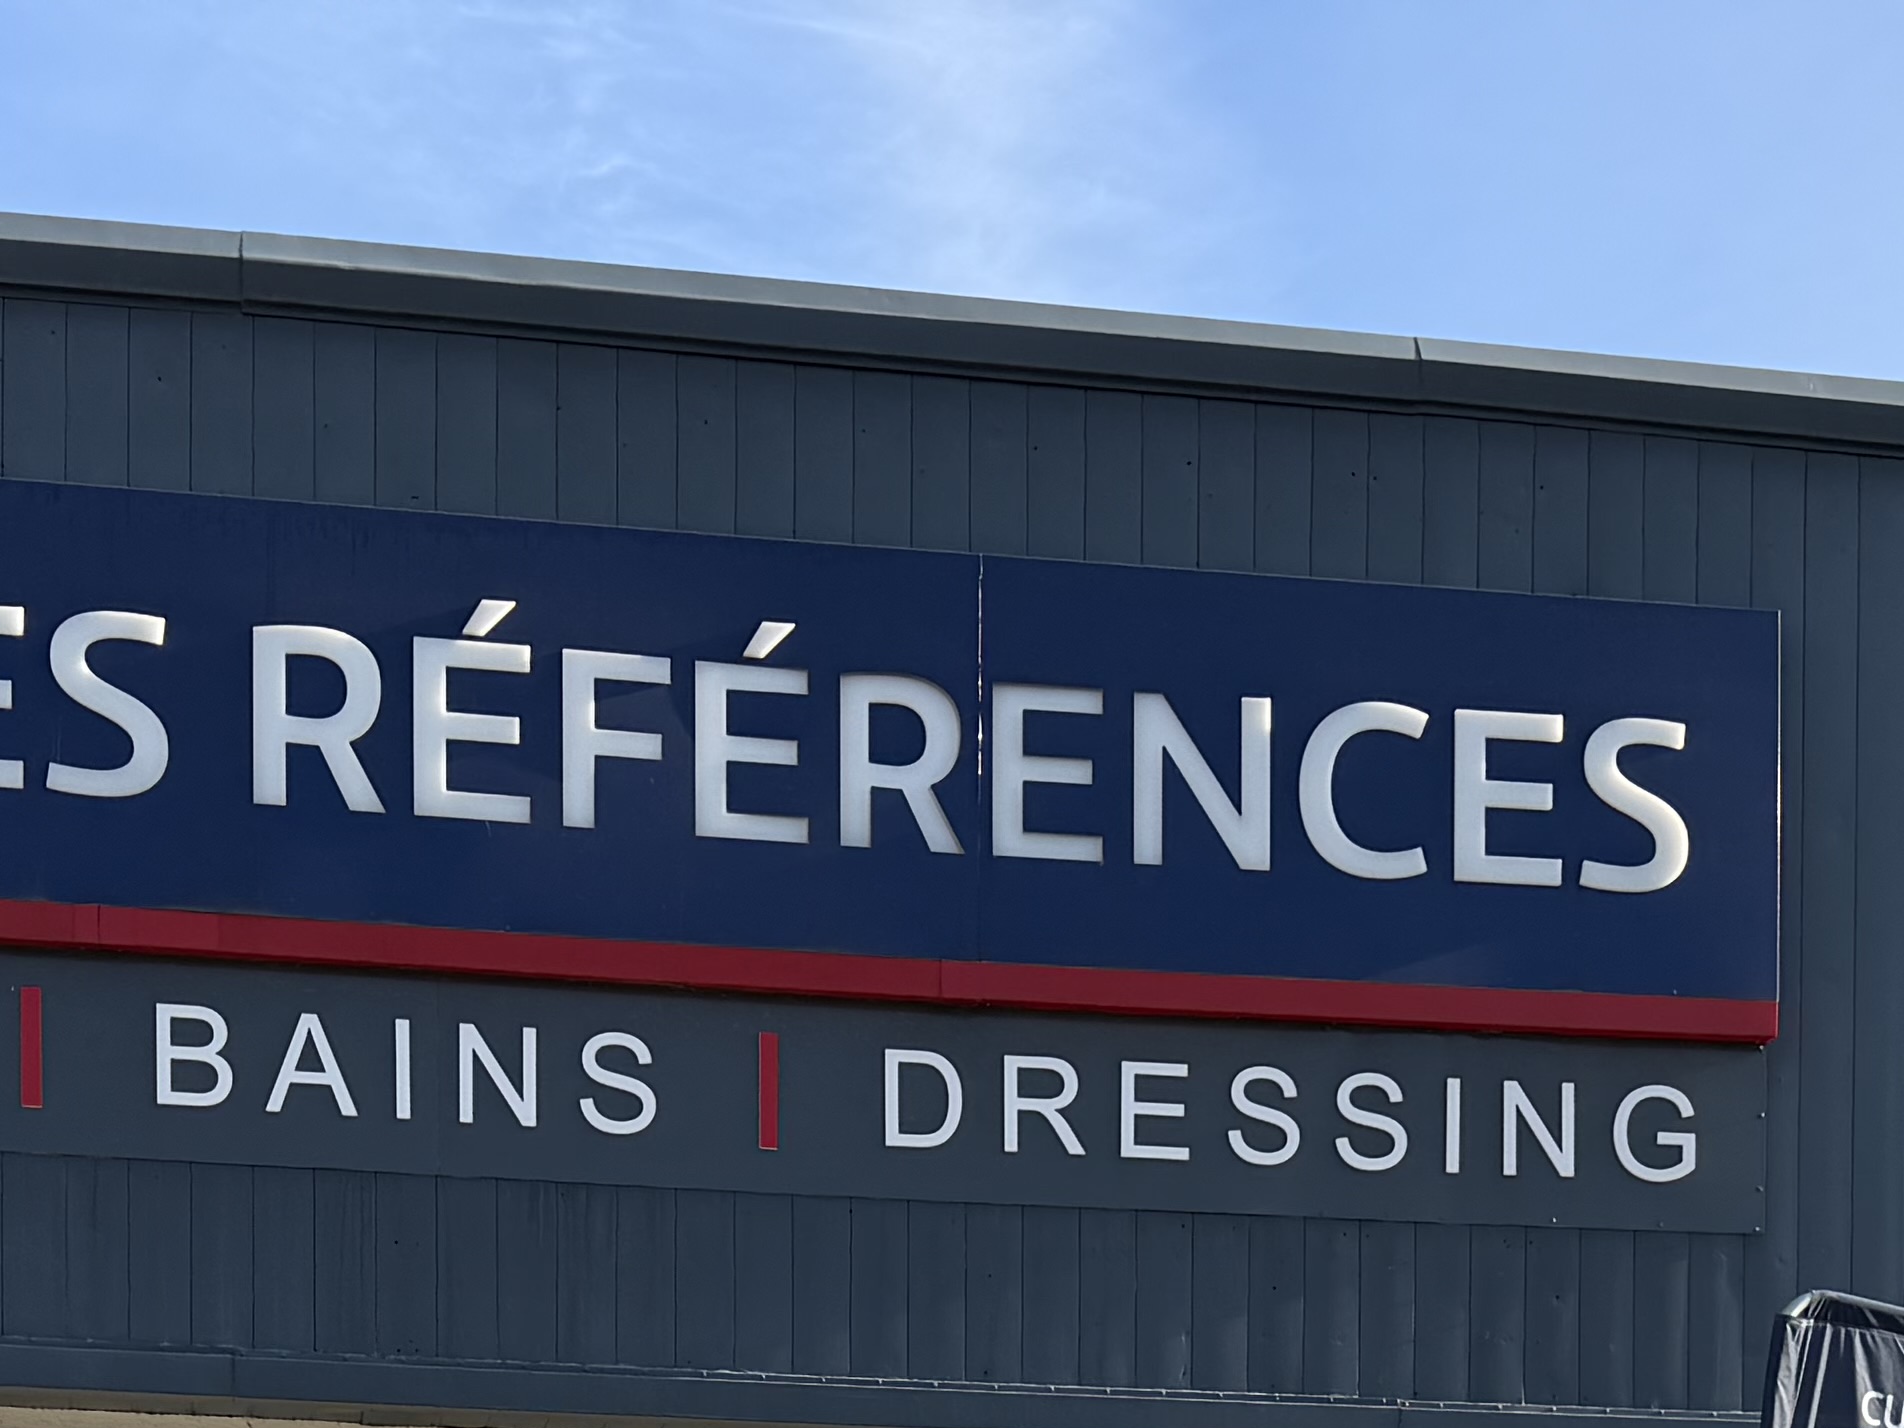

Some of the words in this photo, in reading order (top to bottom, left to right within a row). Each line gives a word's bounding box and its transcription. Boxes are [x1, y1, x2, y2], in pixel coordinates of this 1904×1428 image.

[250, 598, 1691, 895] RÉFÉRENCES
[154, 1002, 659, 1136] BAINS
[883, 1046, 1698, 1184] DRESSING
